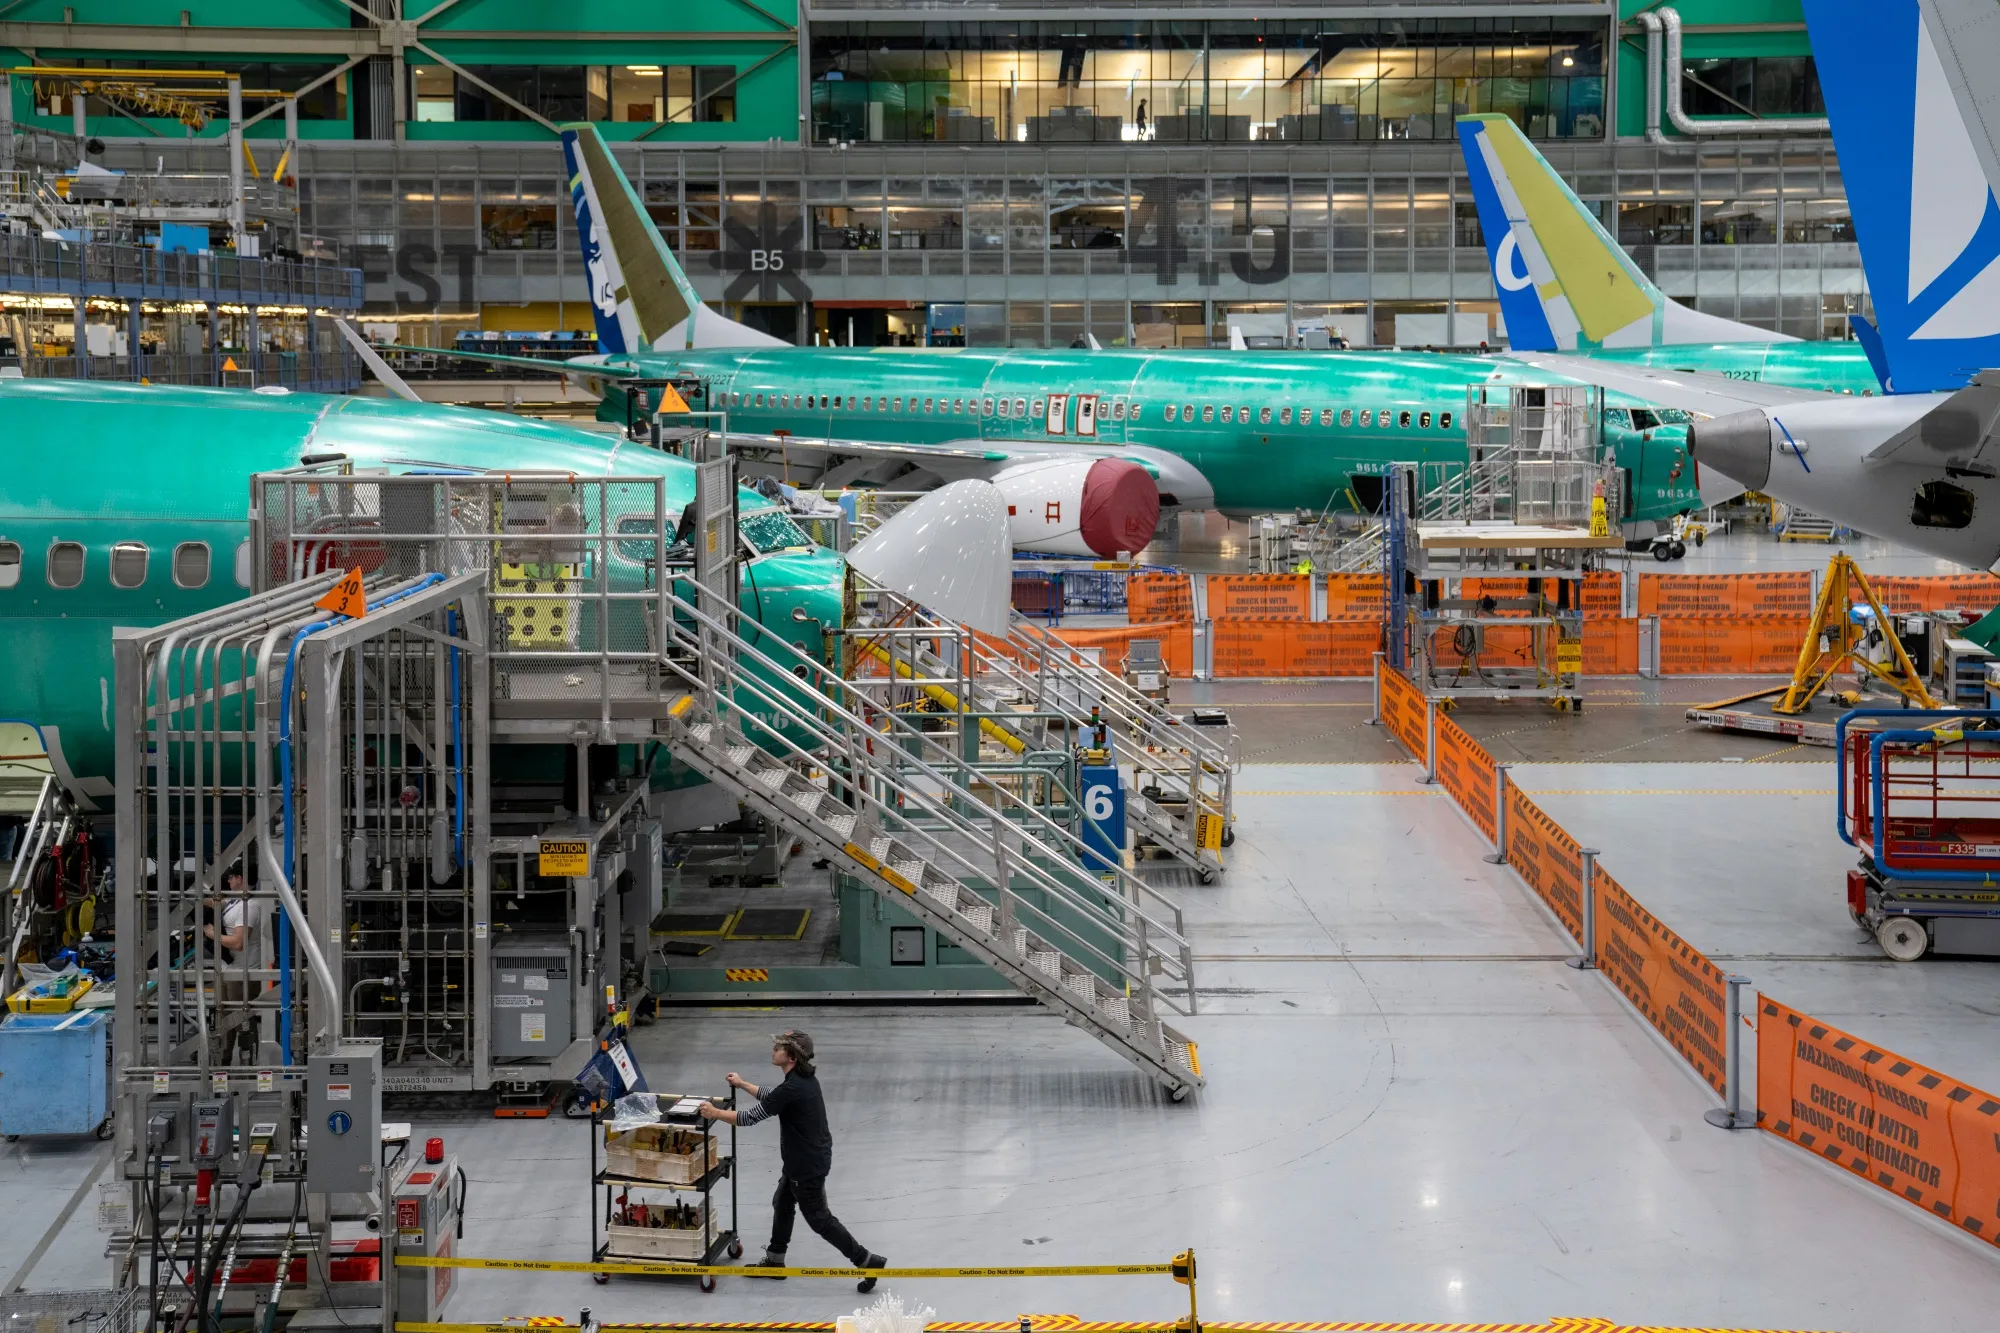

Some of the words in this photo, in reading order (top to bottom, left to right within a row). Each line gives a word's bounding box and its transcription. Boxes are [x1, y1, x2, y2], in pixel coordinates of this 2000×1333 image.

[1118, 176, 1291, 286] 4.5
[751, 249, 784, 271] B5
[1657, 488, 1694, 499] 9654
[338, 580, 358, 596] -10
[1228, 584, 1269, 592] HAZARDOUS
[1270, 584, 1295, 592] ENERGY
[339, 597, 349, 611] 3
[1085, 785, 1113, 820] 6
[1198, 816, 1207, 847] CAUTION
[543, 844, 584, 853] CAUTION
[1948, 844, 1975, 854] F335
[1678, 991, 1697, 1020] CHECK
[1697, 1008, 1704, 1026] IN
[1704, 1015, 1719, 1043] WITH
[1665, 1005, 1686, 1032] GROUP
[1685, 1022, 1726, 1077] COORDINATOR
[1797, 1040, 1875, 1093] HAZARDOUS
[1876, 1079, 1928, 1119] ENERGY
[1811, 1083, 1858, 1121] CHECK
[1859, 1102, 1876, 1129] IN
[1878, 1114, 1919, 1150] WITH
[1791, 1098, 1834, 1134] GROUP
[1837, 1123, 1941, 1188] COORDINATOR
